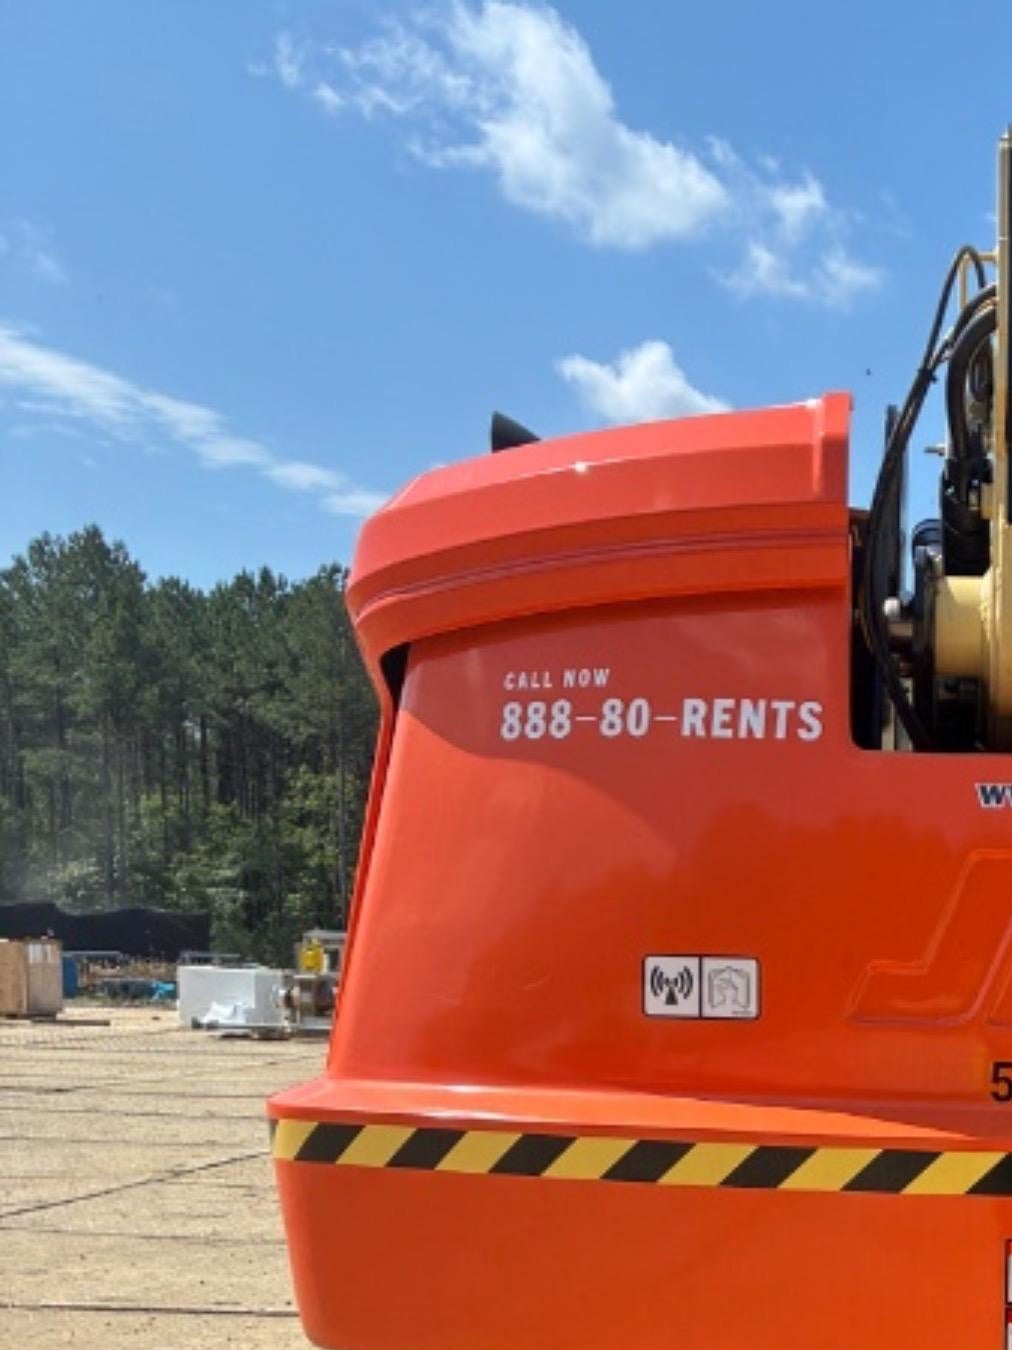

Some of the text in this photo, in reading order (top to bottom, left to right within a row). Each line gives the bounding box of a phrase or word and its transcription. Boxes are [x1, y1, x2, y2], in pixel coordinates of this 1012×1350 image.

[503, 667, 610, 690] CALL NOW
[501, 697, 824, 742] 888-80-RENTS
